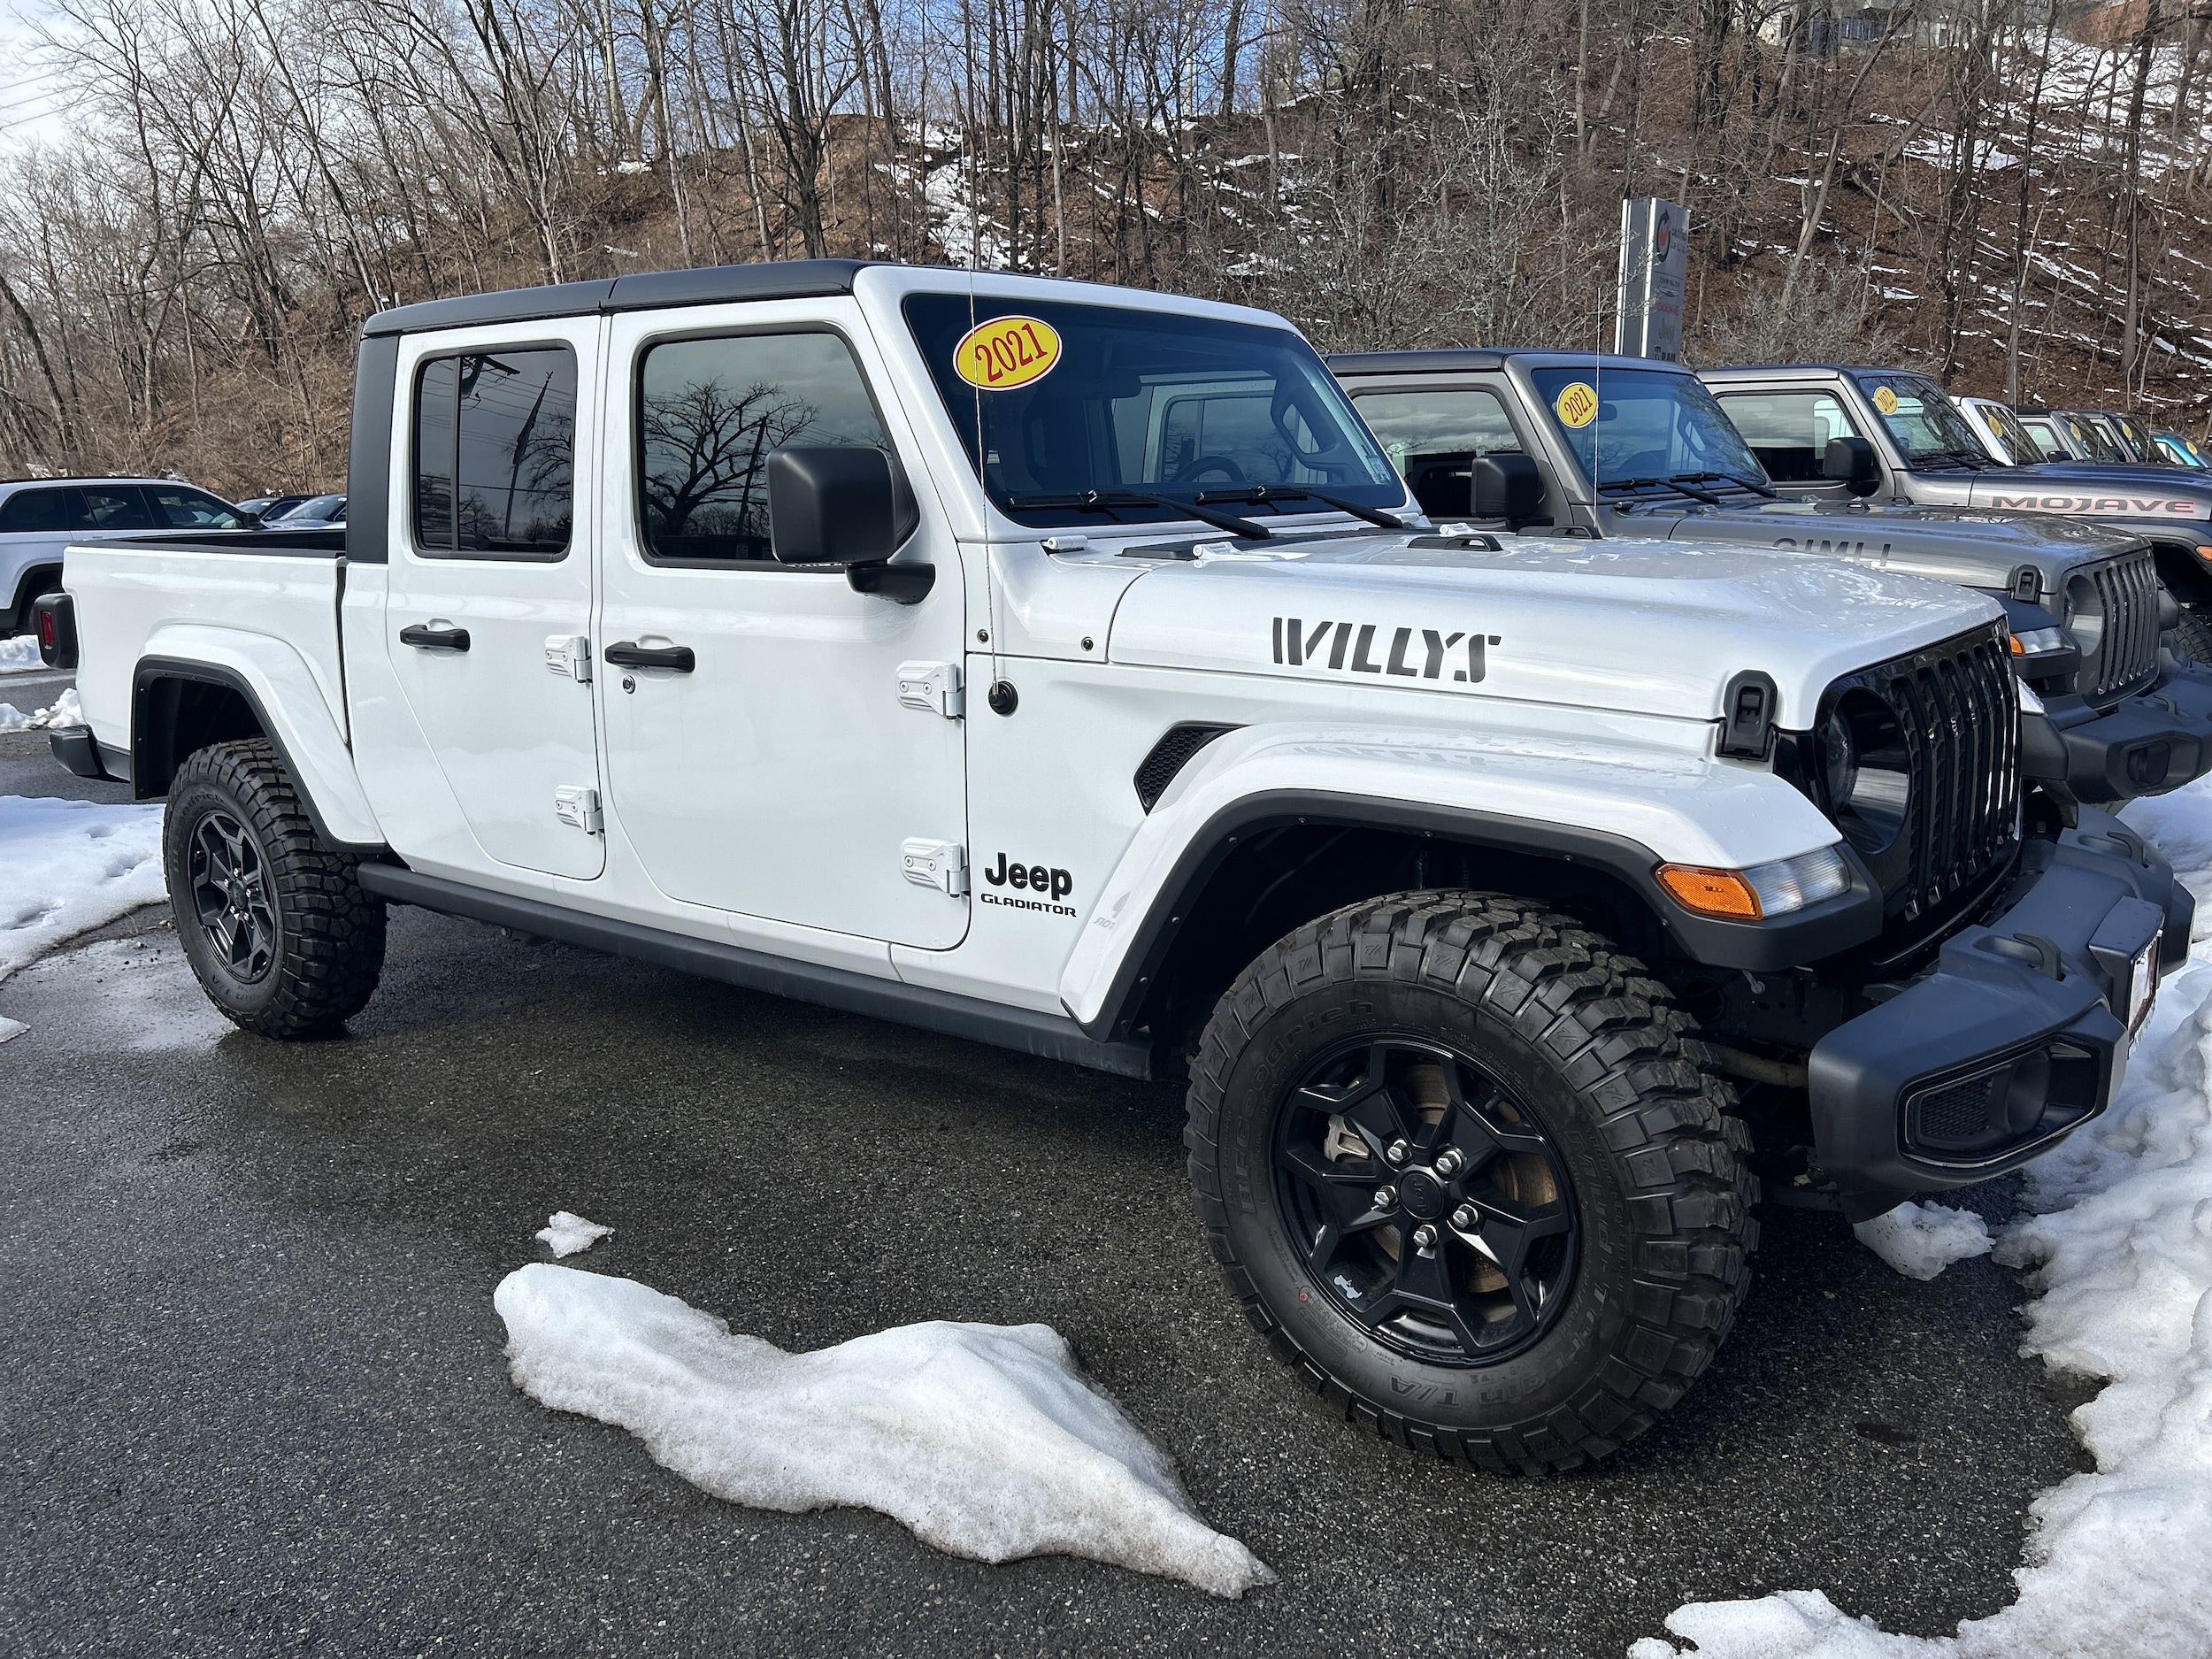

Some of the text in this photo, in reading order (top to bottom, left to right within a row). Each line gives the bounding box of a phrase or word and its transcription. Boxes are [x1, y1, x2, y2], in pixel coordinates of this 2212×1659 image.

[975, 323, 1048, 382] 2021
[1564, 387, 1593, 423] 2021
[1992, 496, 2194, 513] MOJAVE
[1272, 617, 1502, 683] WILLYS
[985, 852, 1073, 901] Jeep
[980, 893, 1078, 918] GLADIATOR
[1237, 999, 1374, 1215] BFGoodrich
[1387, 1373, 1460, 1408] T/A
